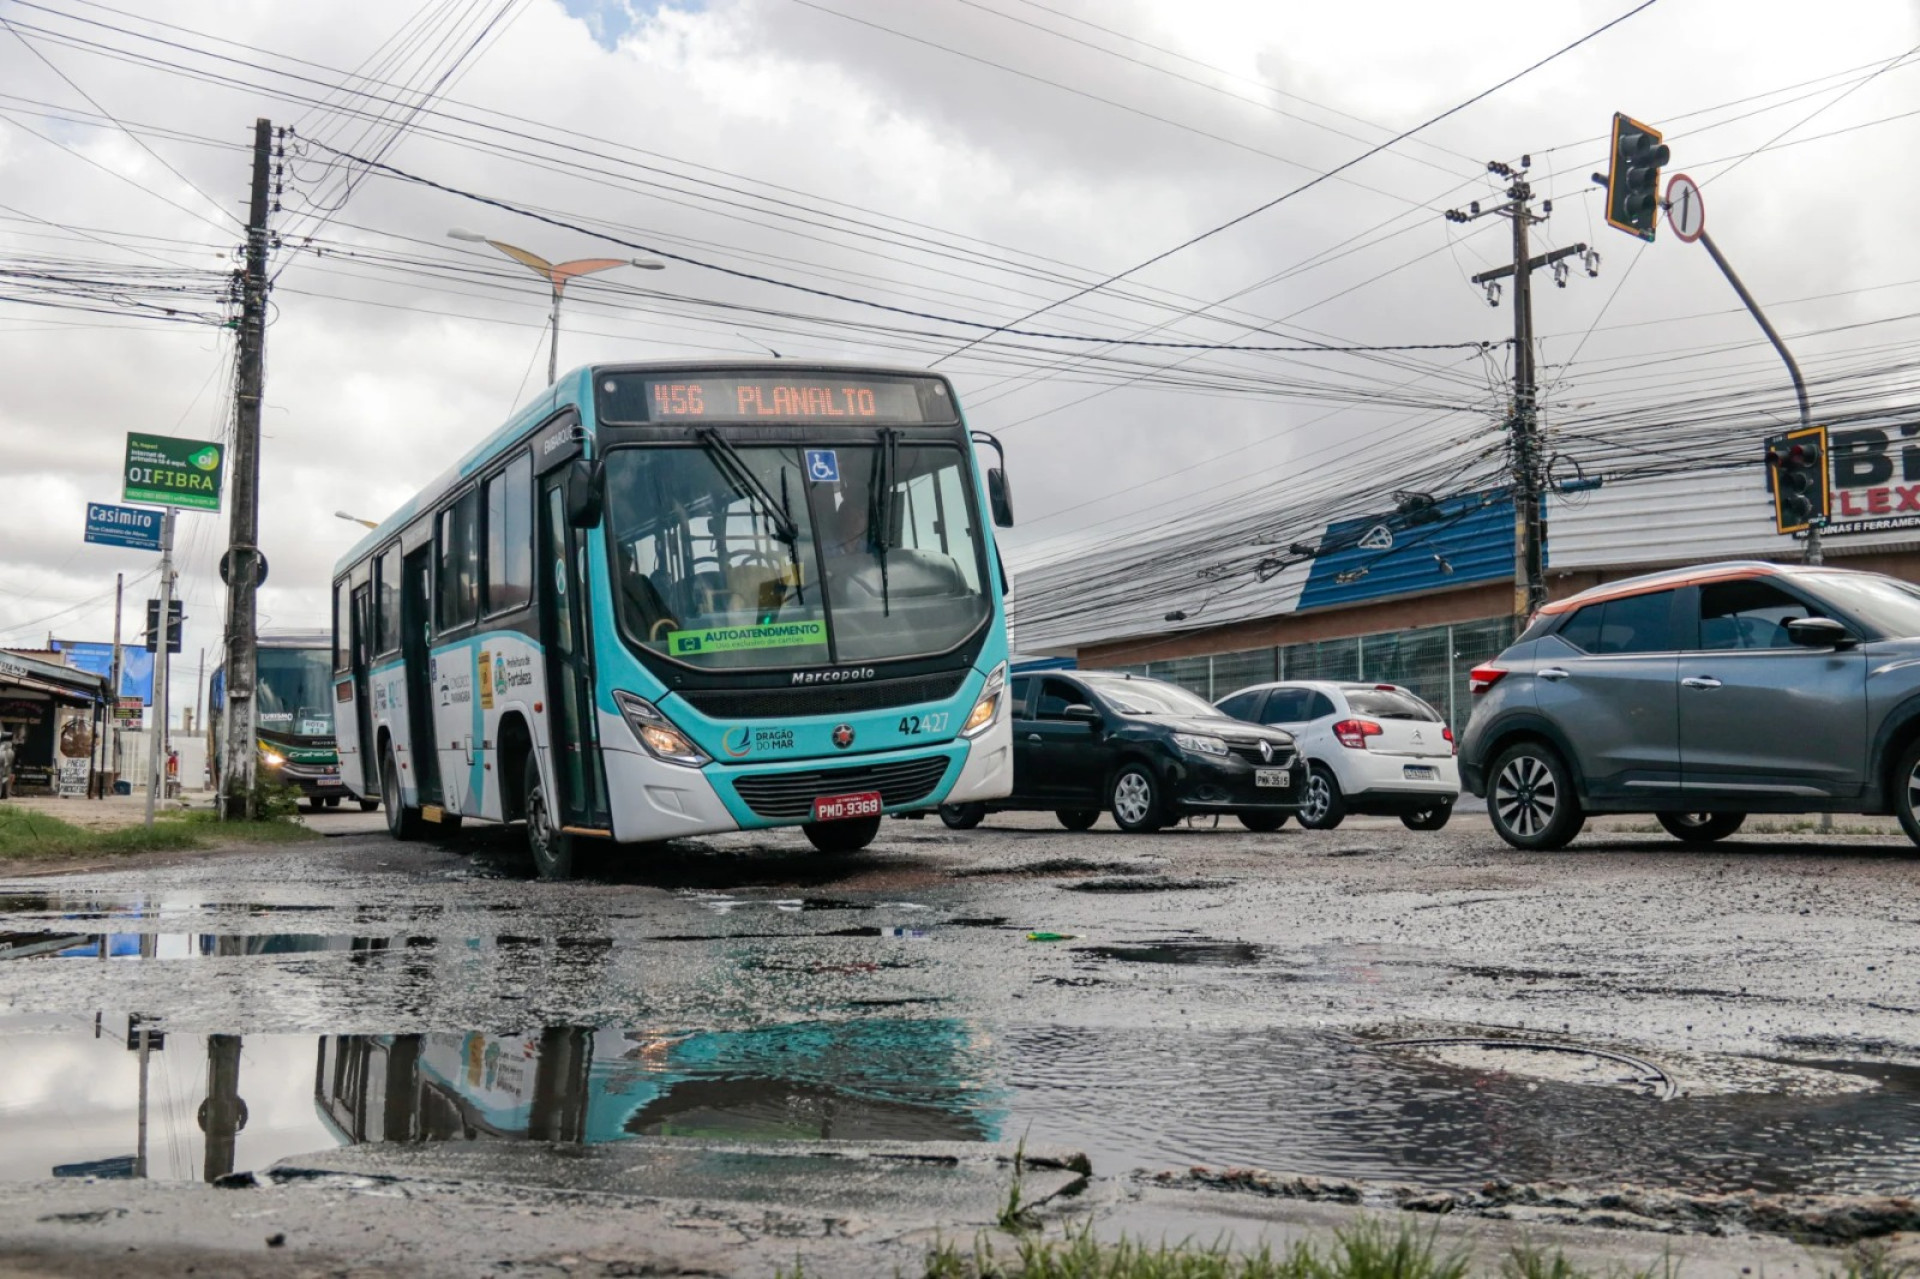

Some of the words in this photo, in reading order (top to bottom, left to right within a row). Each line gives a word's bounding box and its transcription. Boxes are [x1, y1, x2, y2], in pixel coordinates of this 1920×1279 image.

[653, 384, 705, 414] 456
[737, 386, 876, 417] PLANALTO
[1829, 485, 1920, 516] LEX
[89, 505, 152, 528] Casimiro
[1853, 520, 1861, 531] E
[705, 623, 820, 642] AUTOATENDIMENTO
[791, 667, 875, 685] Marcopolo
[260, 713, 292, 721] TURISMO
[898, 712, 949, 736] 42427
[755, 728, 794, 741] DRAGÃO
[756, 741, 770, 751] DO
[772, 739, 794, 750] MAR
